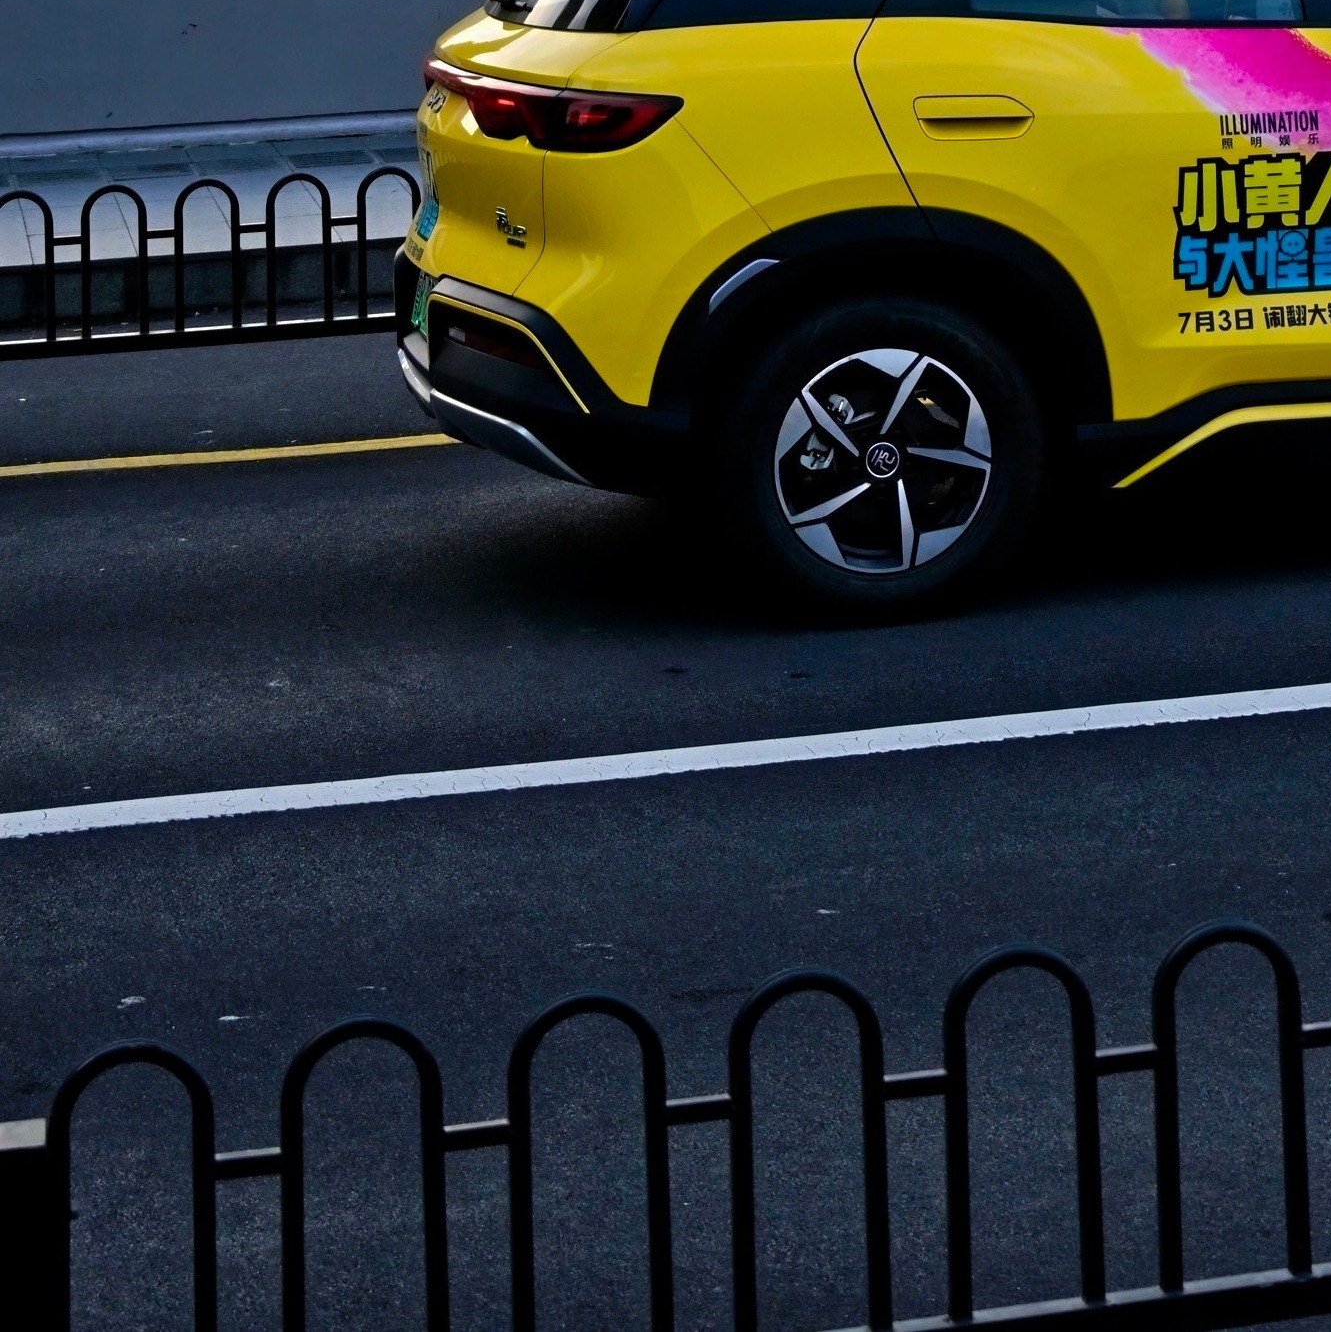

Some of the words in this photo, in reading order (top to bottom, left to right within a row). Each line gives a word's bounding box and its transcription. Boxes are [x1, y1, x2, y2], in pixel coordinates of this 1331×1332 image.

[1219, 110, 1319, 136] ILLUMINATION
[1221, 134, 1320, 149] 照明娱乐
[1178, 308, 1254, 334] 7月3日
